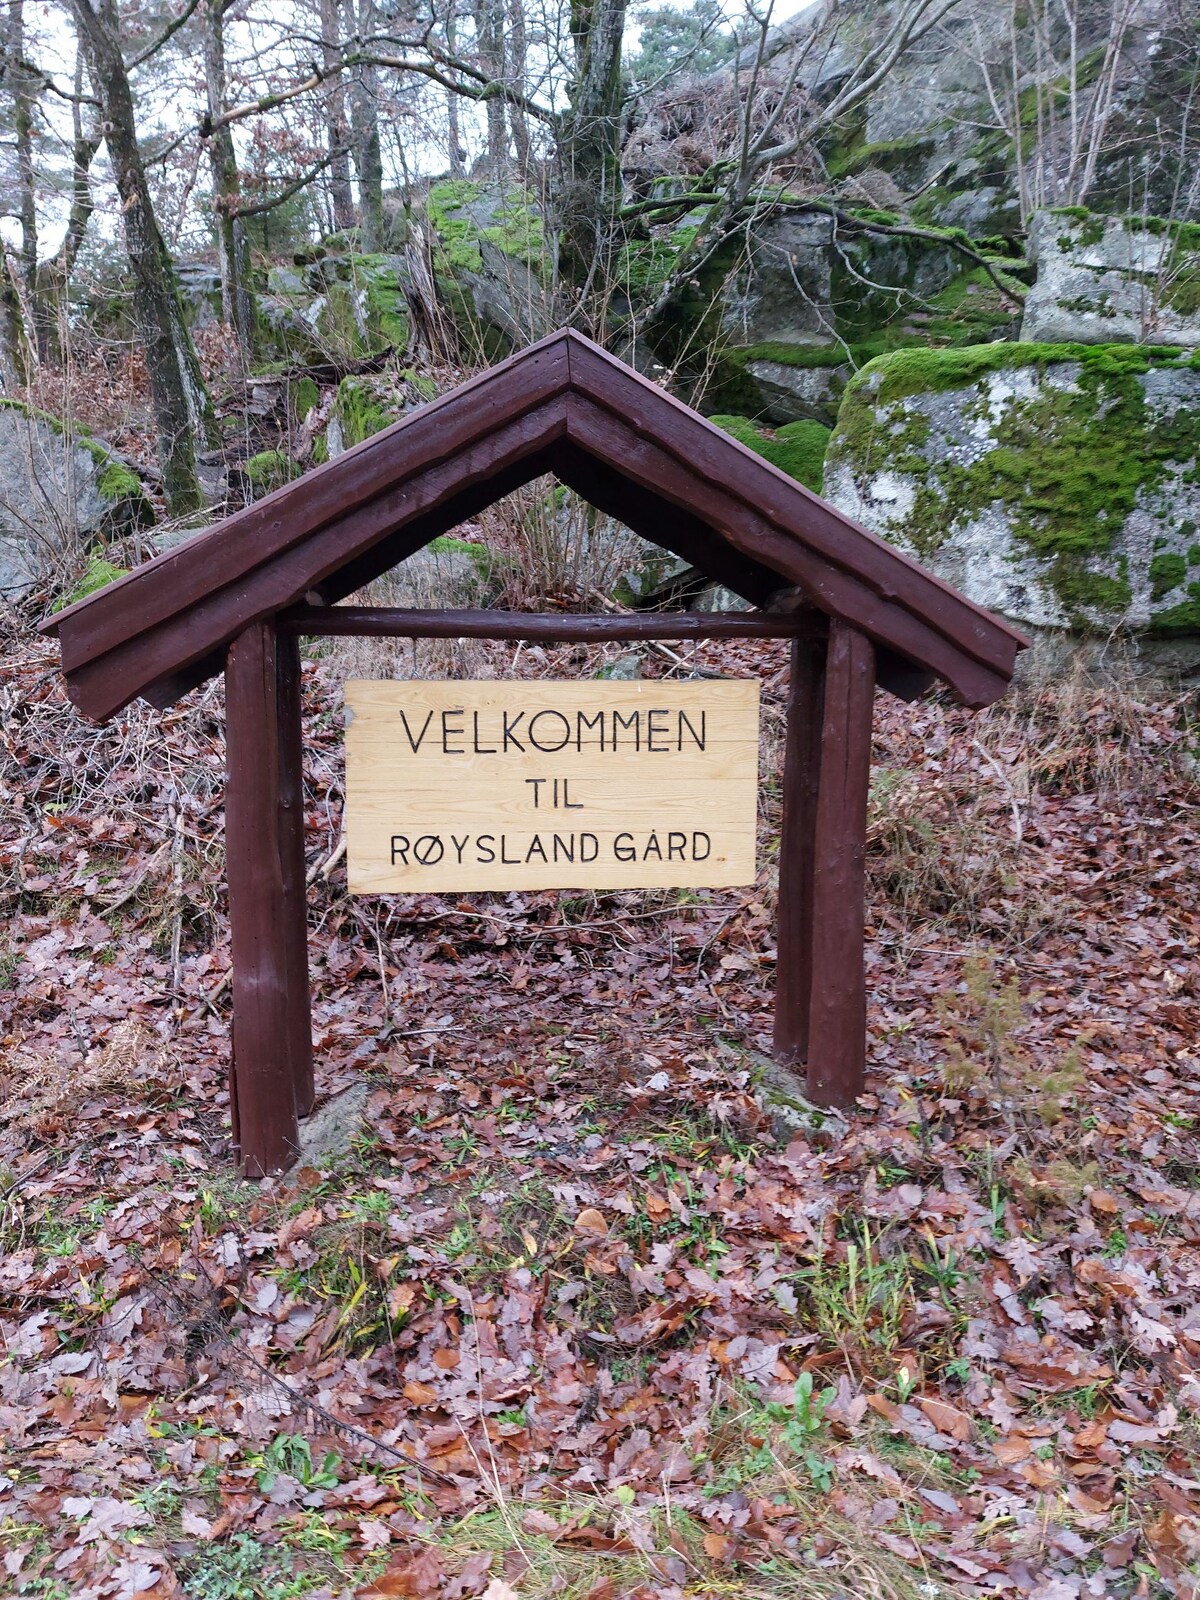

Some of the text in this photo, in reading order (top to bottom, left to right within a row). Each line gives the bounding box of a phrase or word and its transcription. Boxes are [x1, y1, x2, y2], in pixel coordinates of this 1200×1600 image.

[399, 709, 706, 754] VELKOMMEN
[525, 778, 584, 808] TIL
[391, 829, 711, 865] RØYSLAND GÅRD
